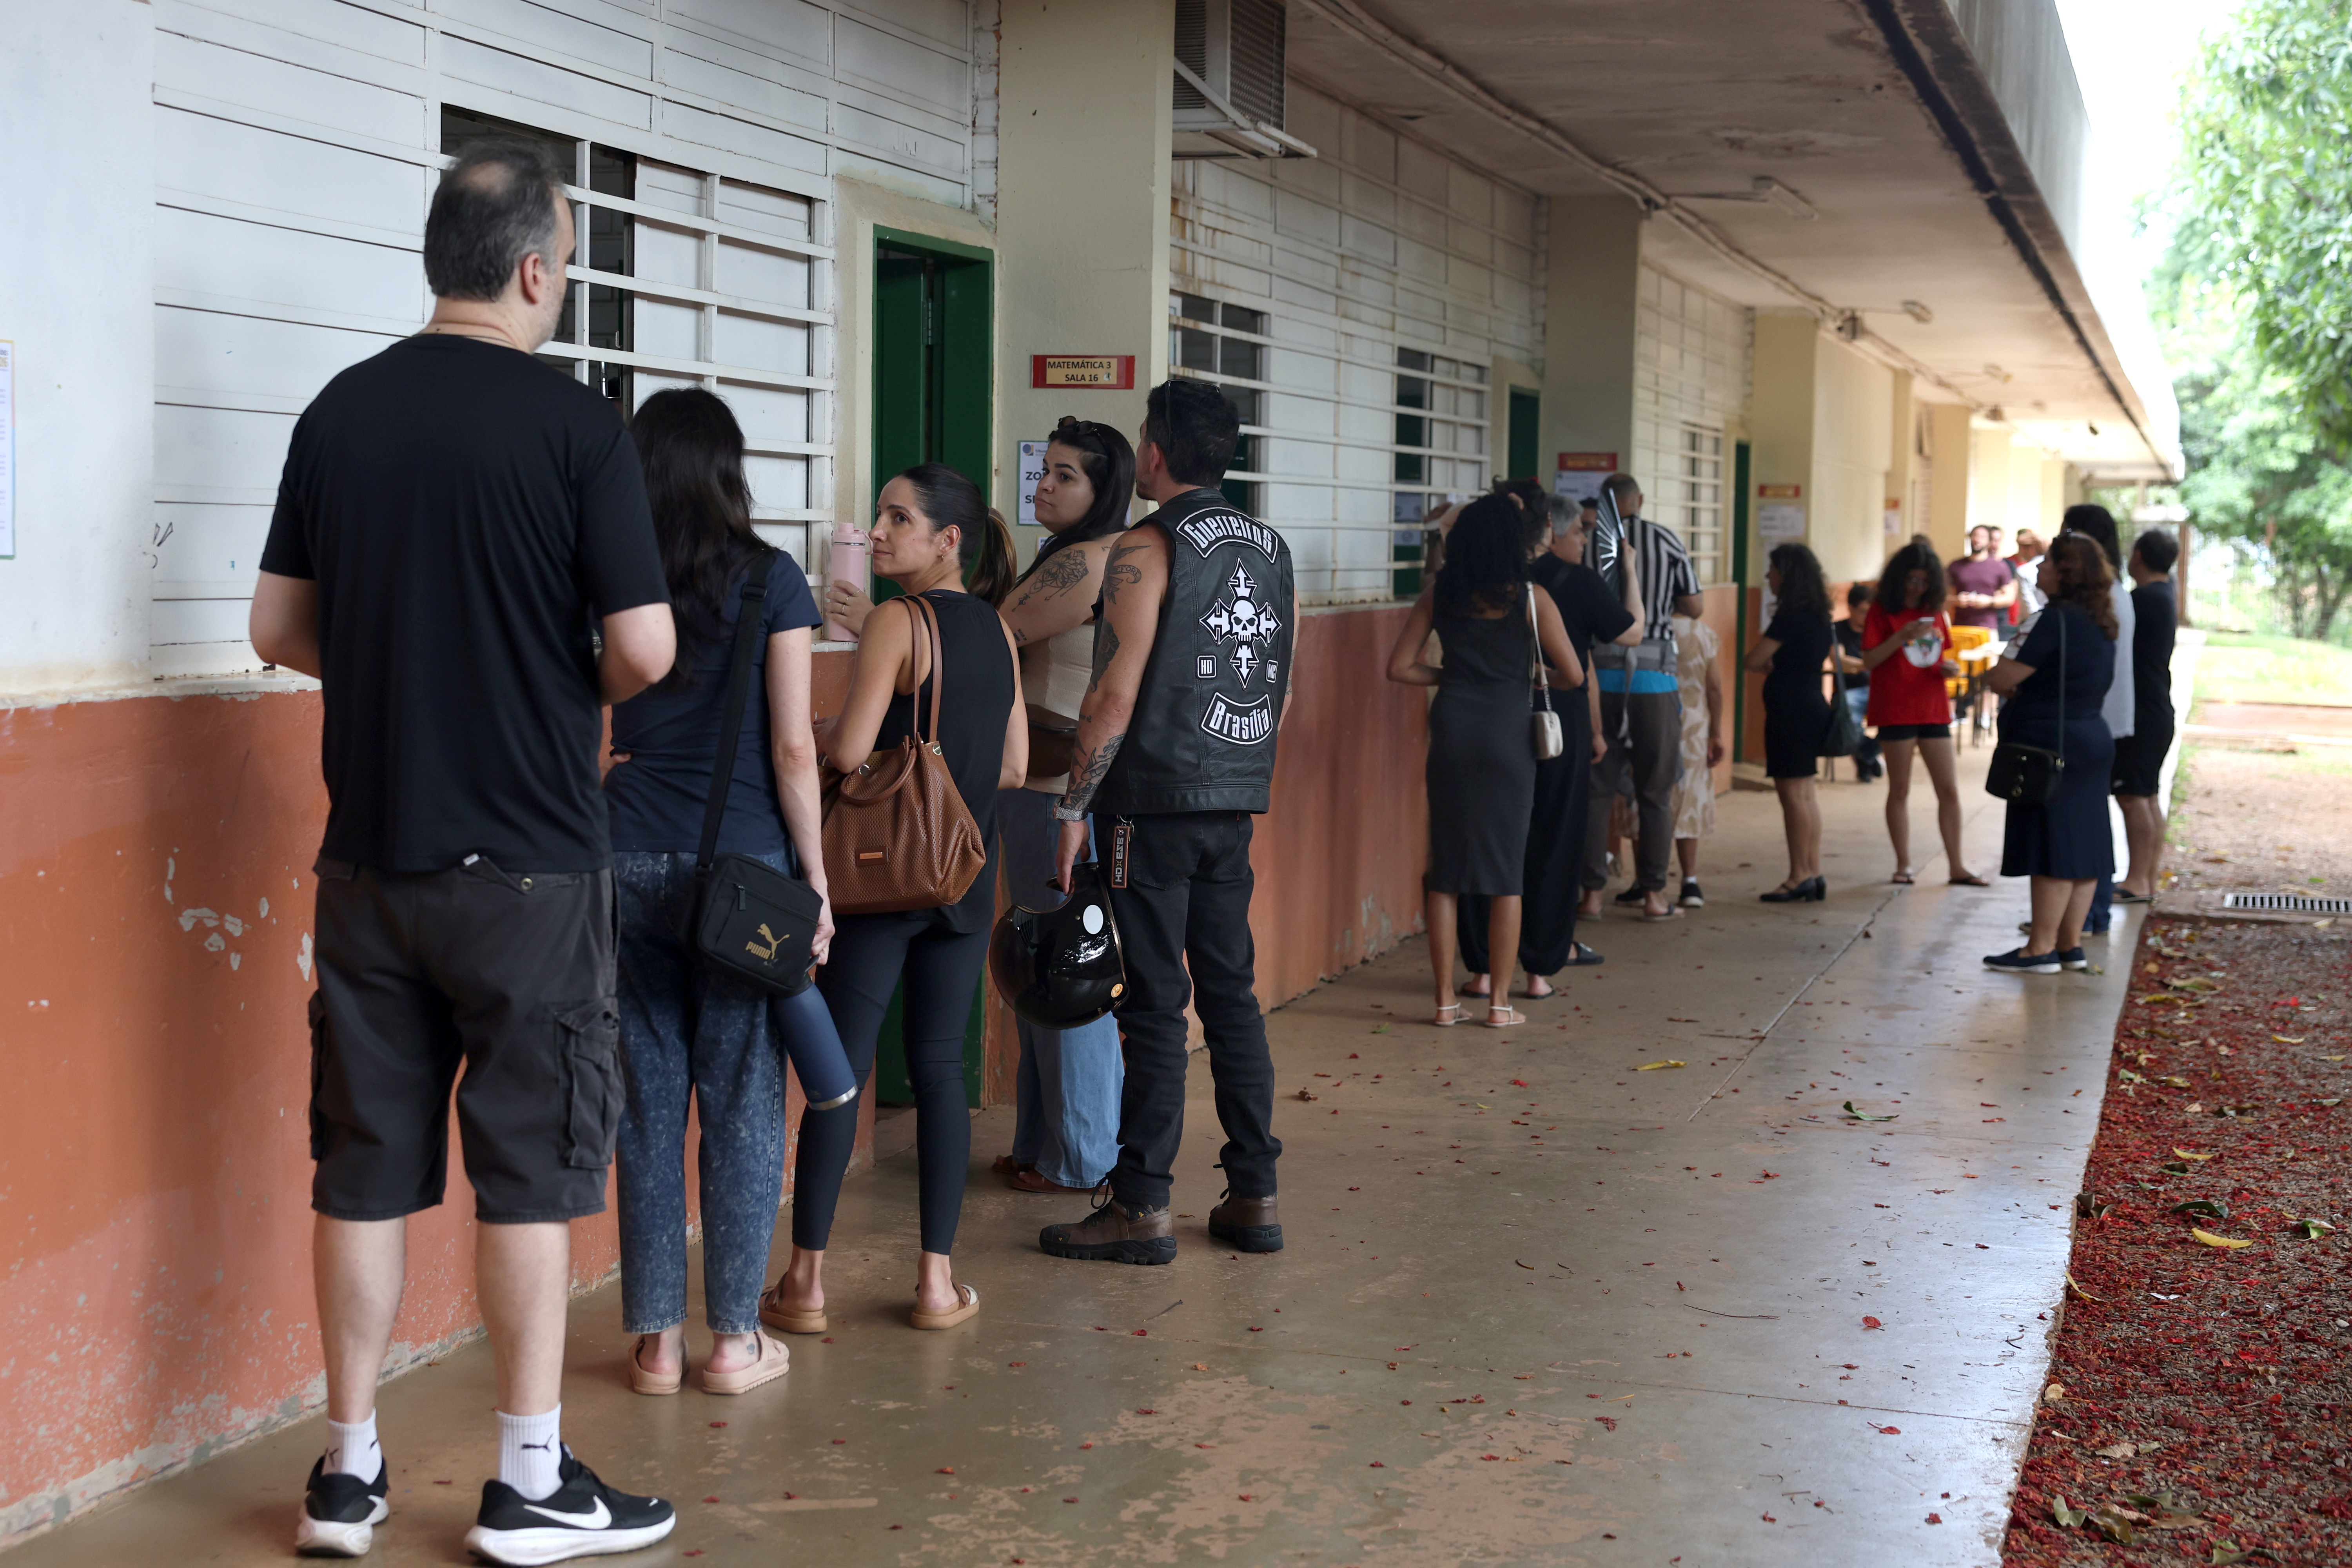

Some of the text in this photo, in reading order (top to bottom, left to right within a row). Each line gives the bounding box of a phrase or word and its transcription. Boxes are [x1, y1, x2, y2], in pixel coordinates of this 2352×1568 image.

[1048, 360, 1104, 368] MATEMÁTICA
[1184, 515, 1272, 551] Guerreiros
[1201, 659, 1212, 674] HD
[1268, 664, 1276, 679] MC
[1209, 701, 1270, 739] Brasília
[746, 941, 771, 960] PUMA
